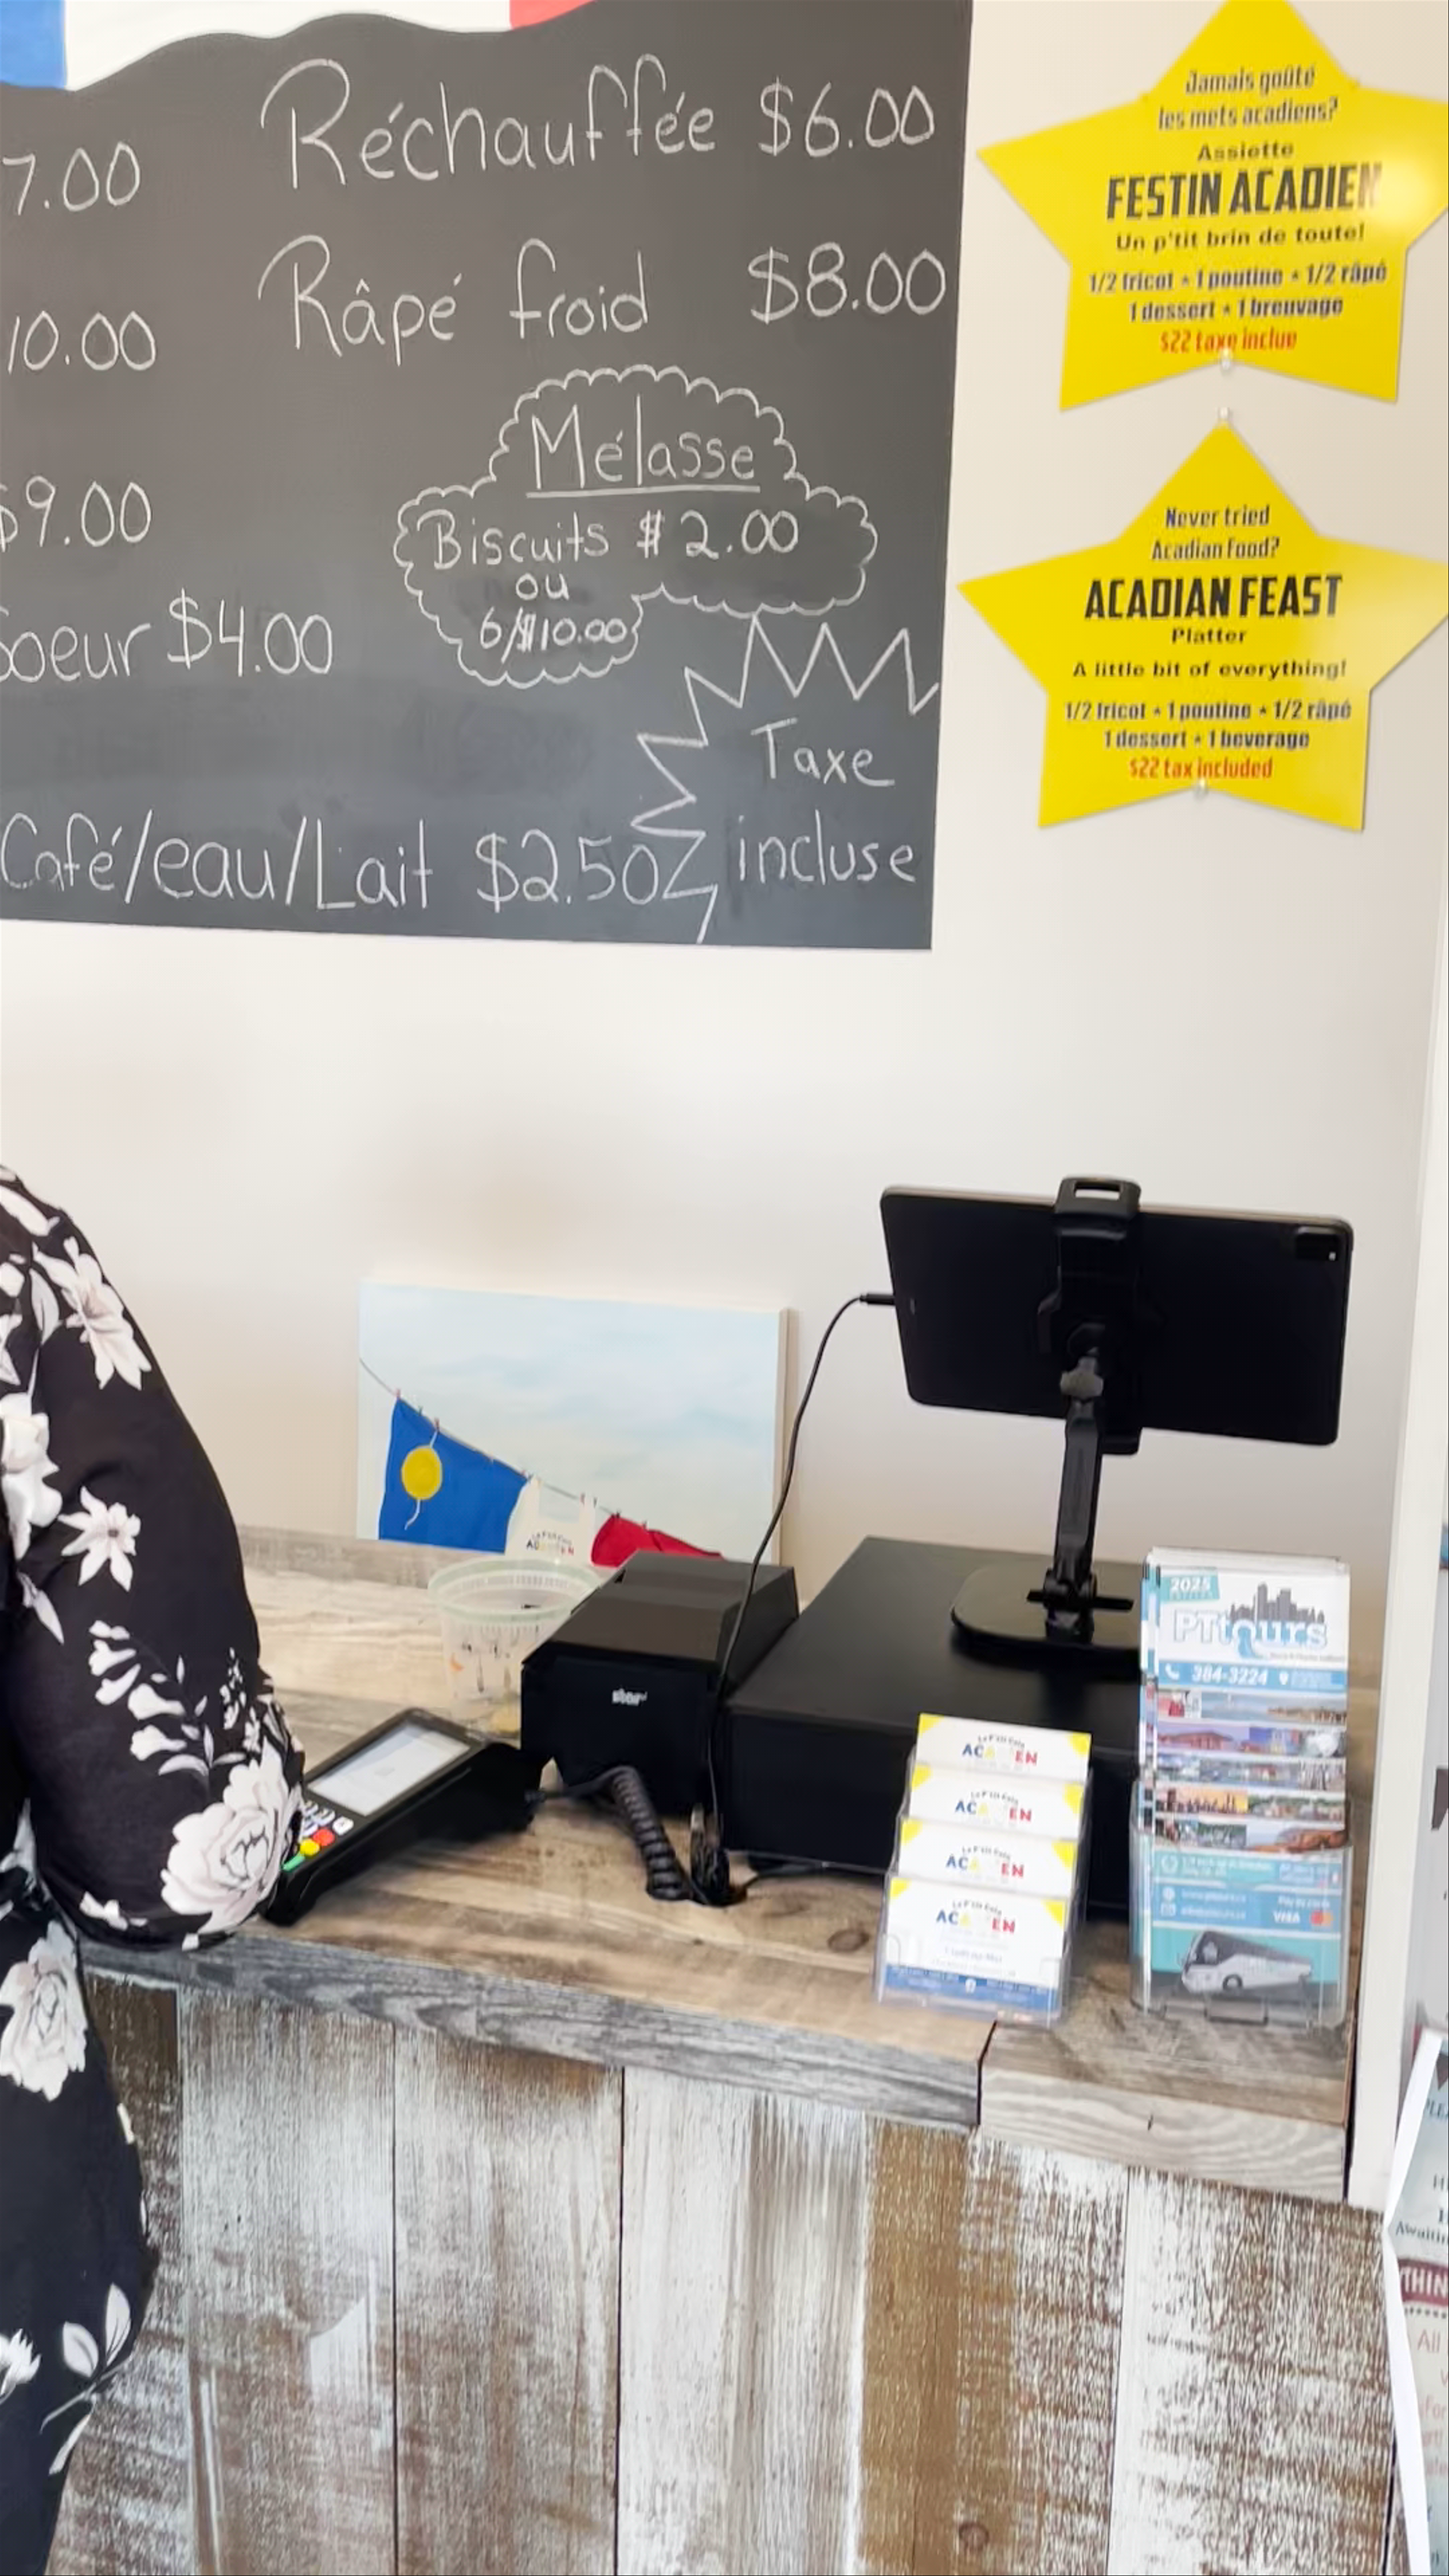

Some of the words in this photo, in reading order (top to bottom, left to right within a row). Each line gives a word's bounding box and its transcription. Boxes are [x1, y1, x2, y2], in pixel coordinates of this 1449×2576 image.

[1186, 66, 1254, 95] Jamais
[1260, 63, 1315, 96] goûté
[260, 54, 715, 189] Réchauffée
[758, 76, 934, 157] $6.00
[1159, 106, 1184, 131] les
[1190, 104, 1237, 128] mets
[1243, 96, 1338, 125] acadiens?
[1197, 141, 1294, 161] Assiette
[2, 141, 140, 215] 7.00
[1107, 171, 1222, 220] FESTIN
[1229, 162, 1382, 214] ACADIEN
[1115, 234, 1145, 250] Un
[1154, 231, 1197, 253] p'tit
[1208, 229, 1250, 248] brin
[1259, 228, 1286, 245] de
[1296, 224, 1364, 243] toute!
[1089, 273, 1117, 294] 1/2
[1122, 271, 1174, 291] fricot
[1197, 269, 1204, 288] 1
[1208, 268, 1283, 290] poutine
[1306, 263, 1336, 285] 1/2
[1341, 262, 1387, 285] râpé
[258, 234, 462, 367] Râpé
[509, 238, 648, 339] froid
[748, 242, 946, 324] $8.00
[1129, 301, 1137, 322] 1
[1141, 300, 1215, 321] dessert
[1238, 299, 1245, 318] 1
[1250, 296, 1343, 319] breuvage
[7, 310, 157, 374] 10.00
[1160, 331, 1191, 353] $22
[1195, 329, 1237, 352] taxe
[1241, 326, 1297, 351] inclue
[531, 394, 755, 490] Mélasse
[1166, 506, 1218, 527] Never
[1224, 503, 1270, 526] tried
[416, 509, 609, 569] Biscuits
[1152, 537, 1222, 560] Acadian
[514, 573, 569, 601] ou
[1084, 577, 1231, 619] ACADIAN
[1239, 574, 1343, 617] FEAST
[167, 587, 333, 676] $4.00
[1171, 627, 1247, 644] Platter
[1073, 662, 1086, 677] A
[1095, 661, 1144, 677] little
[1153, 660, 1181, 677] bit
[1189, 660, 1211, 677] of
[1219, 659, 1346, 681] everything!
[1065, 702, 1092, 720] 1/2
[1097, 701, 1146, 718] fricot
[1168, 701, 1175, 718] 1
[1180, 700, 1252, 721] poutine
[1273, 700, 1302, 718] 1/2
[1307, 700, 1352, 721] râpé
[751, 718, 895, 787] Taxe
[1104, 730, 1111, 748] 1
[1116, 730, 1187, 748] dessert
[1208, 730, 1215, 747] 1
[1220, 729, 1310, 750] beverage
[1129, 759, 1160, 778] $22
[1164, 758, 1192, 778] tax
[1197, 757, 1273, 778] included
[738, 810, 916, 885] incluse
[475, 829, 658, 913] $2.50
[1170, 1576, 1211, 1592] 2025
[1192, 1663, 1269, 1686] 384-3224
[1417, 2329, 1441, 2353] All
